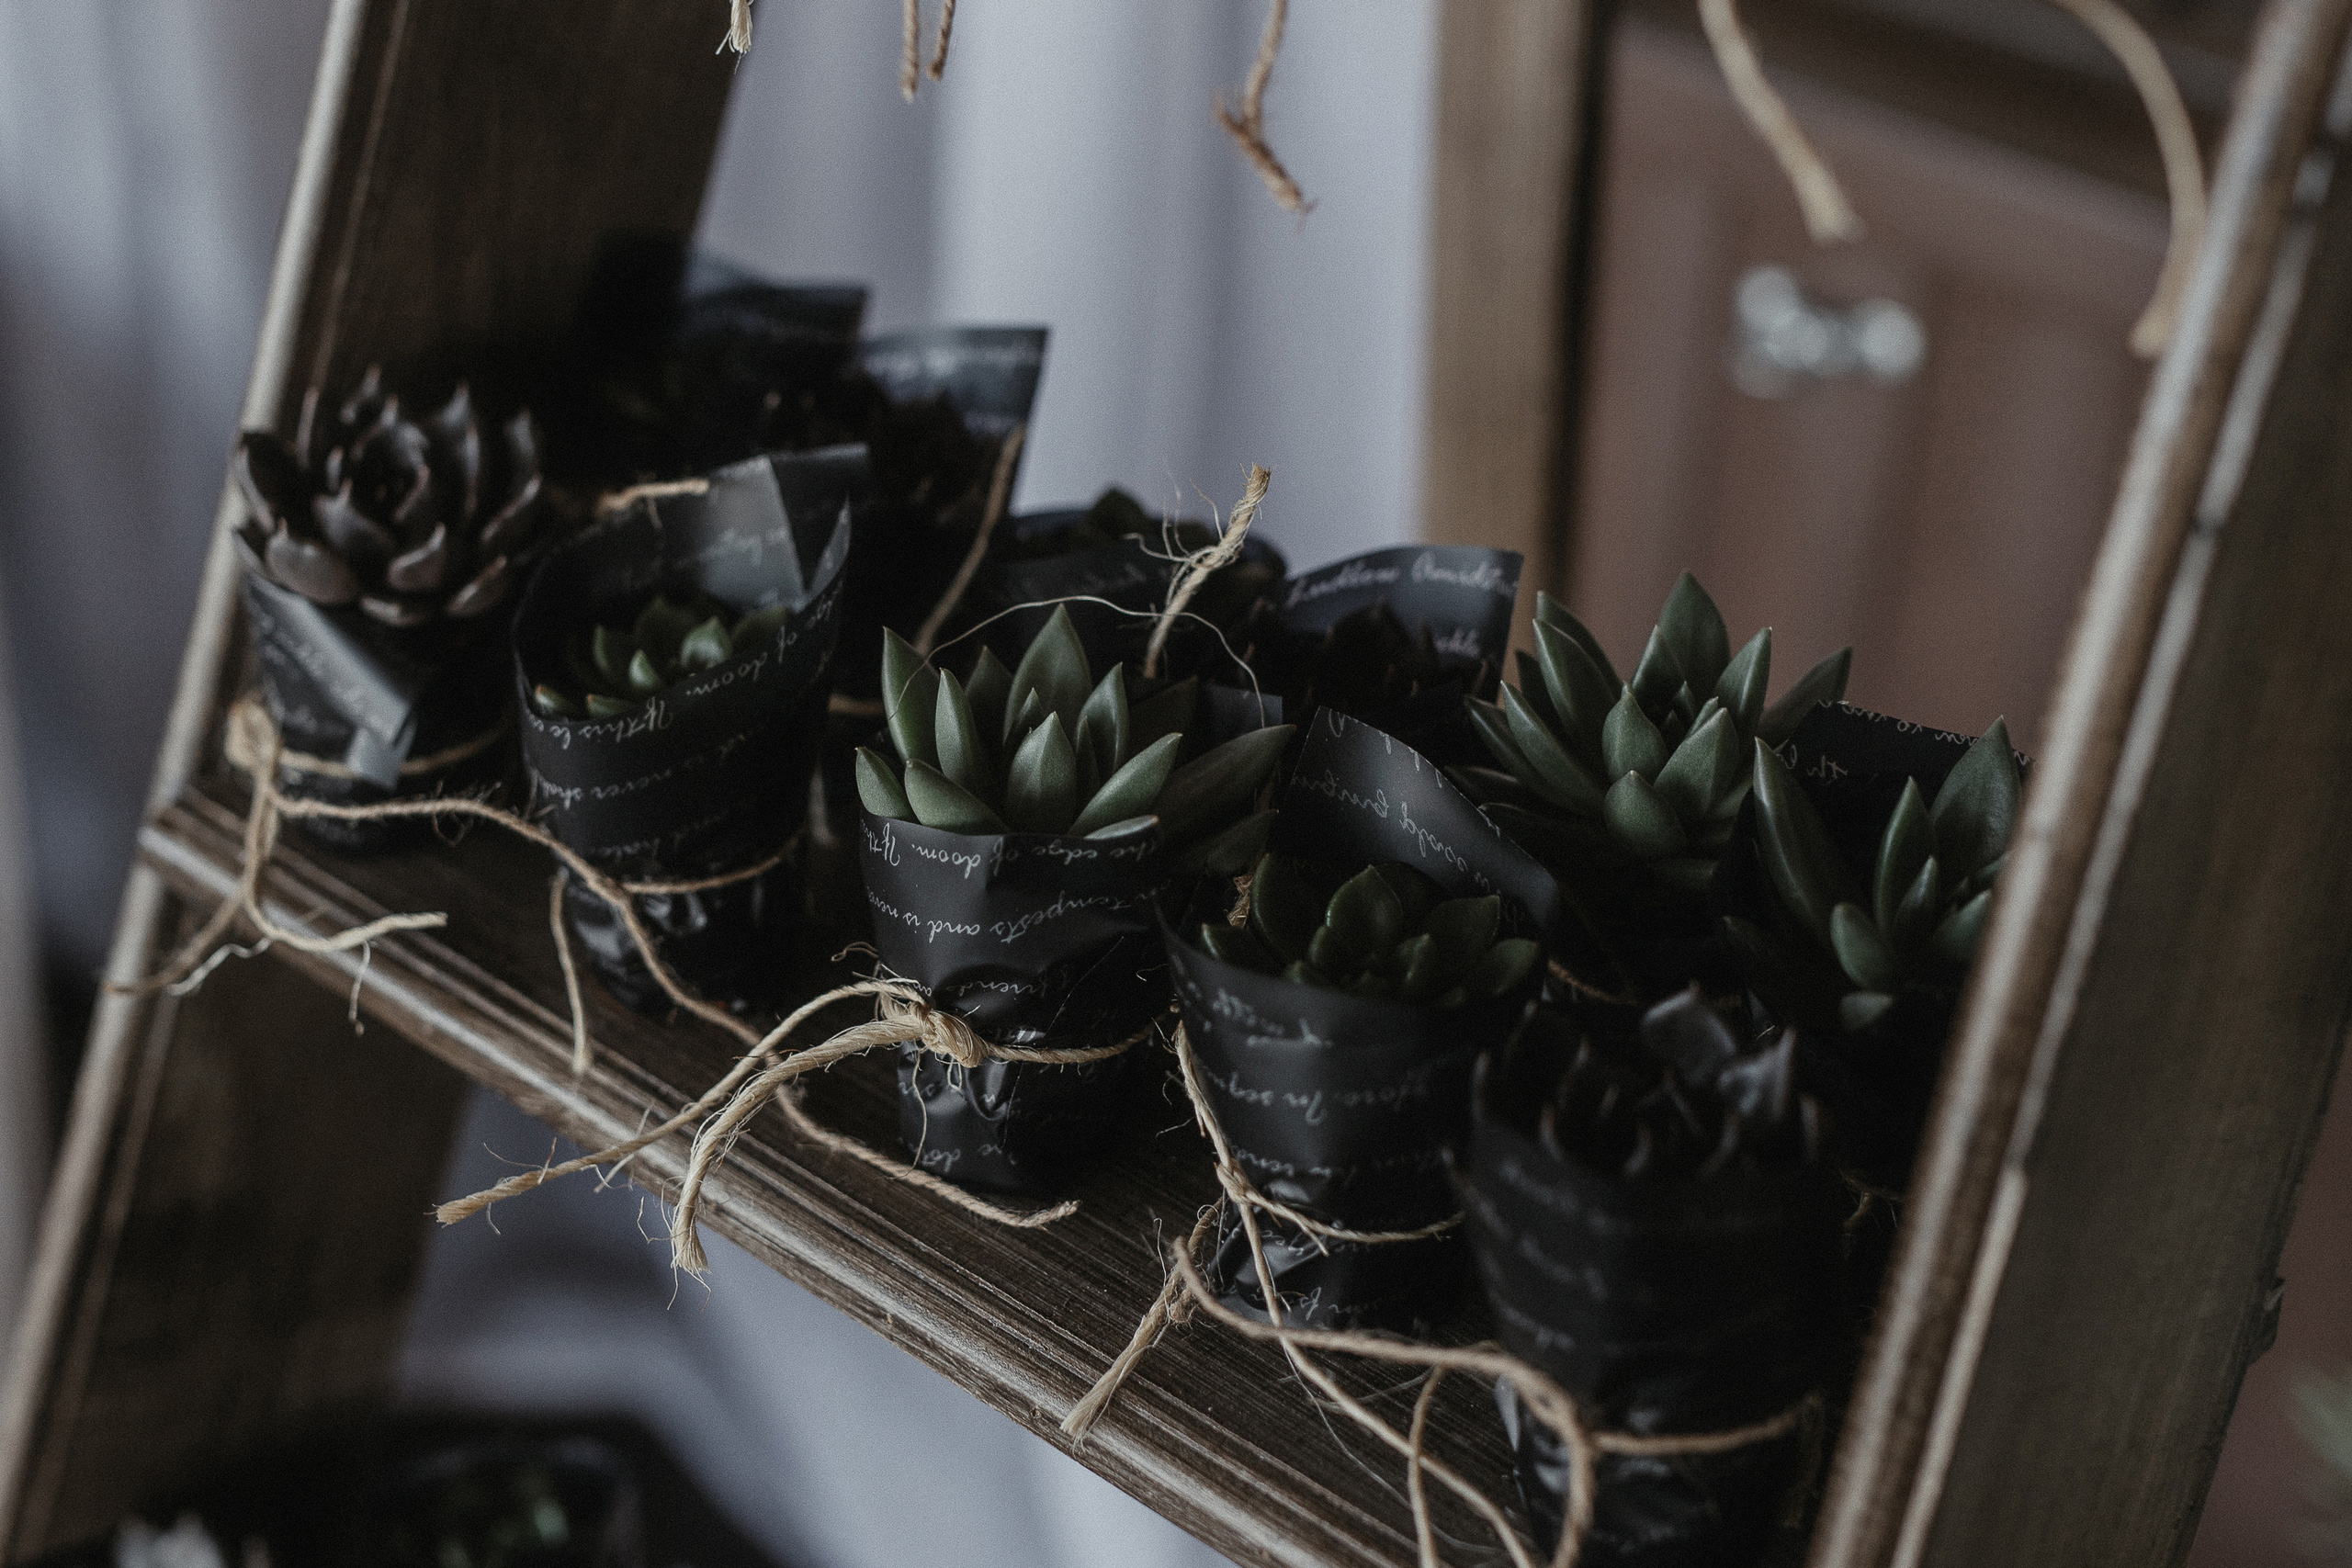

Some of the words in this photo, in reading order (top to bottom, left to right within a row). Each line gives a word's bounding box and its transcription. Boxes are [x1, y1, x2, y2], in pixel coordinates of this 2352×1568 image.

[589, 769, 673, 802] never
[910, 843, 982, 879] doom.
[987, 837, 1020, 877] of
[1031, 840, 1100, 866] edge
[1109, 837, 1158, 863] the
[903, 911, 922, 934] is
[926, 919, 981, 944] and
[988, 889, 1132, 945] tempests
